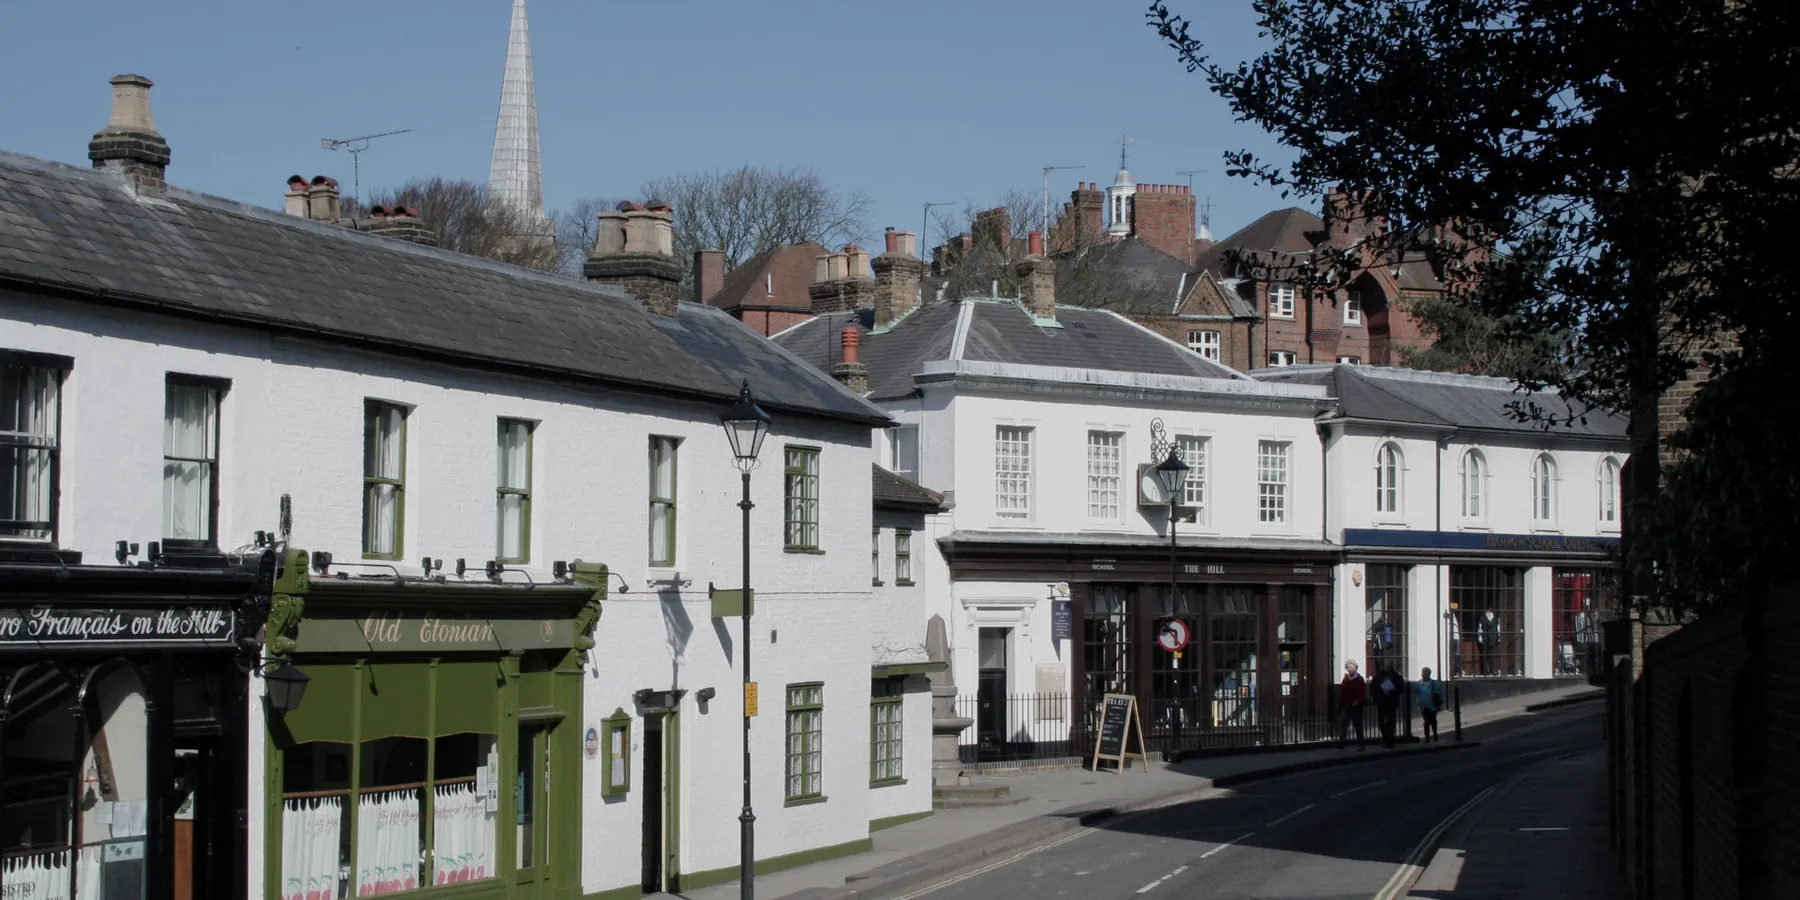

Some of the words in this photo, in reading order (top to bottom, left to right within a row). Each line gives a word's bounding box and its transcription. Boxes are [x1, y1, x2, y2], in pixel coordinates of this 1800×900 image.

[1184, 564, 1199, 573] THE
[1207, 565, 1225, 574] HILL
[28, 606, 127, 640] Français
[131, 616, 153, 634] on
[157, 609, 180, 634] the
[364, 611, 402, 643] Old
[420, 612, 494, 643] Etonian
[2, 881, 36, 898] BISTRO
